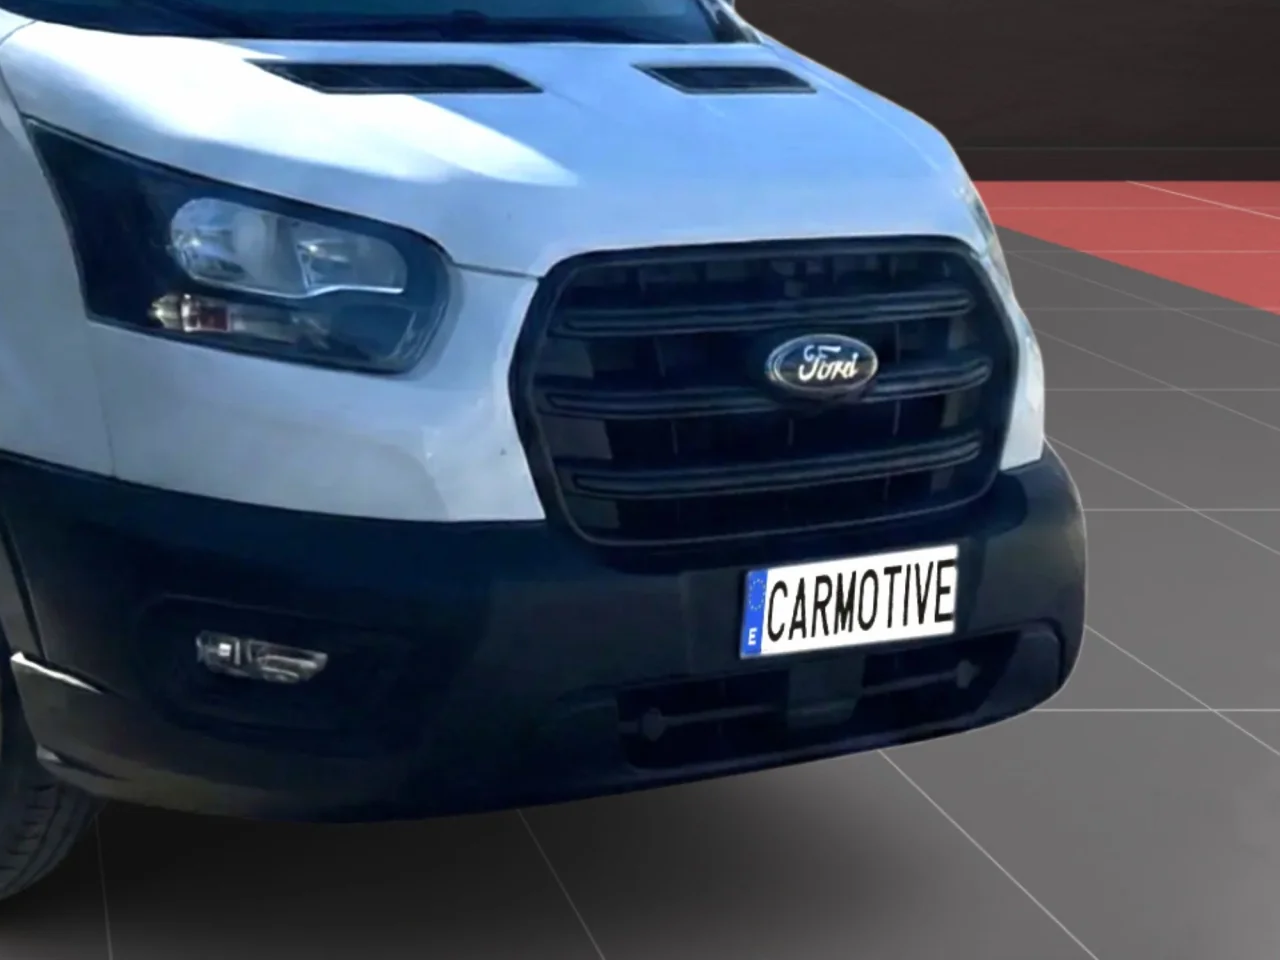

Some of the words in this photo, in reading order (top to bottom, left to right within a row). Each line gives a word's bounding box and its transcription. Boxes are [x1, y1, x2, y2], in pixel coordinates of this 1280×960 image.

[797, 344, 859, 381] Ford
[767, 558, 956, 642] CARMOTIVE
[747, 627, 758, 646] E
